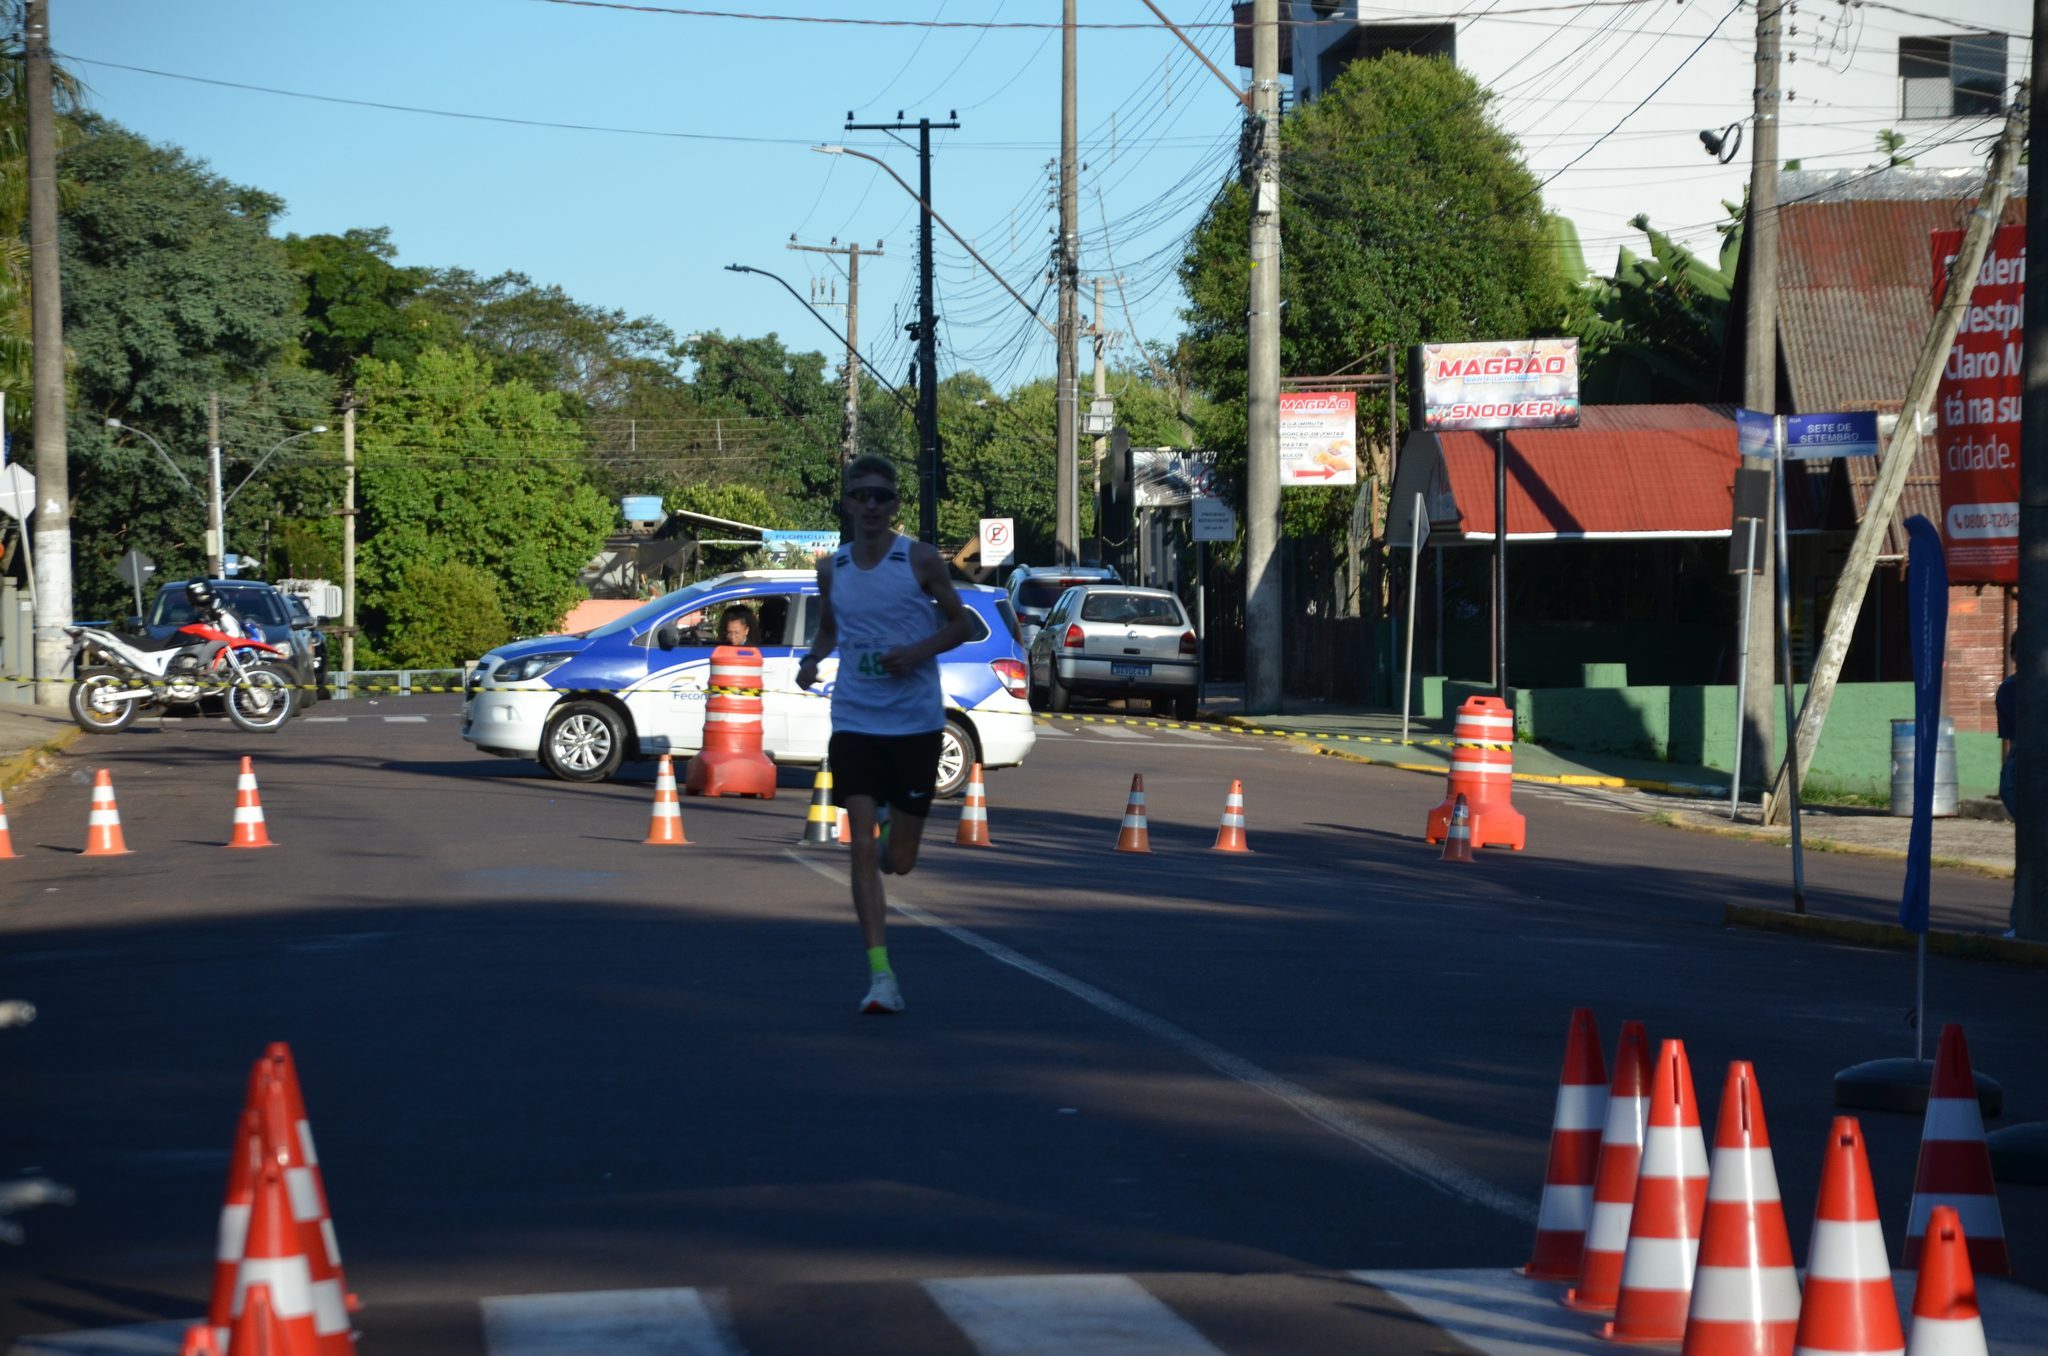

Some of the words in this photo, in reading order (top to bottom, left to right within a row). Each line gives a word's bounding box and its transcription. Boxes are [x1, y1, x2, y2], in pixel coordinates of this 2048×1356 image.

[1437, 350, 1567, 378] MAGRÃO
[1944, 343, 2000, 380] Claro
[1281, 396, 1350, 410] MAGRÃO
[1451, 402, 1555, 420] SNOOKER
[1944, 390, 1965, 426] tá
[1967, 397, 1994, 424] na
[1800, 432, 1860, 443] SETEMBRO
[1807, 423, 1835, 434] SETE
[1837, 422, 1852, 432] DE
[1948, 433, 2016, 471] cidade.
